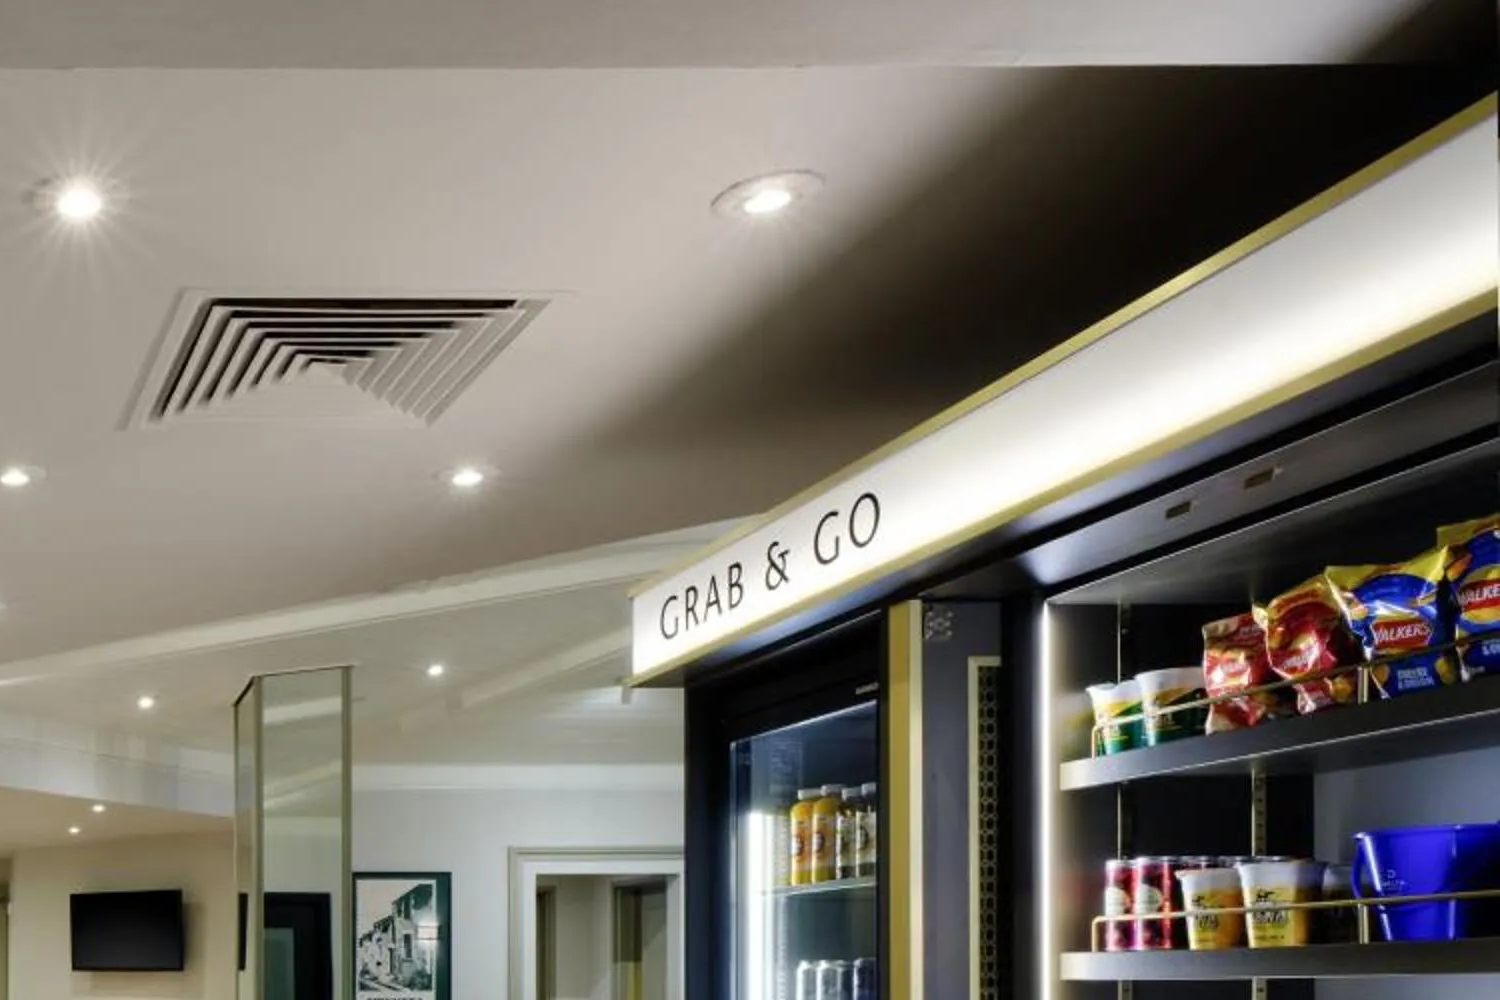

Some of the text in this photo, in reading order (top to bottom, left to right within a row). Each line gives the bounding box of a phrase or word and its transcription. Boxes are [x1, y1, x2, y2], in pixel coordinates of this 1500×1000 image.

[658, 492, 881, 640] GRAB & GO
[1375, 623, 1430, 643] WALKERS
